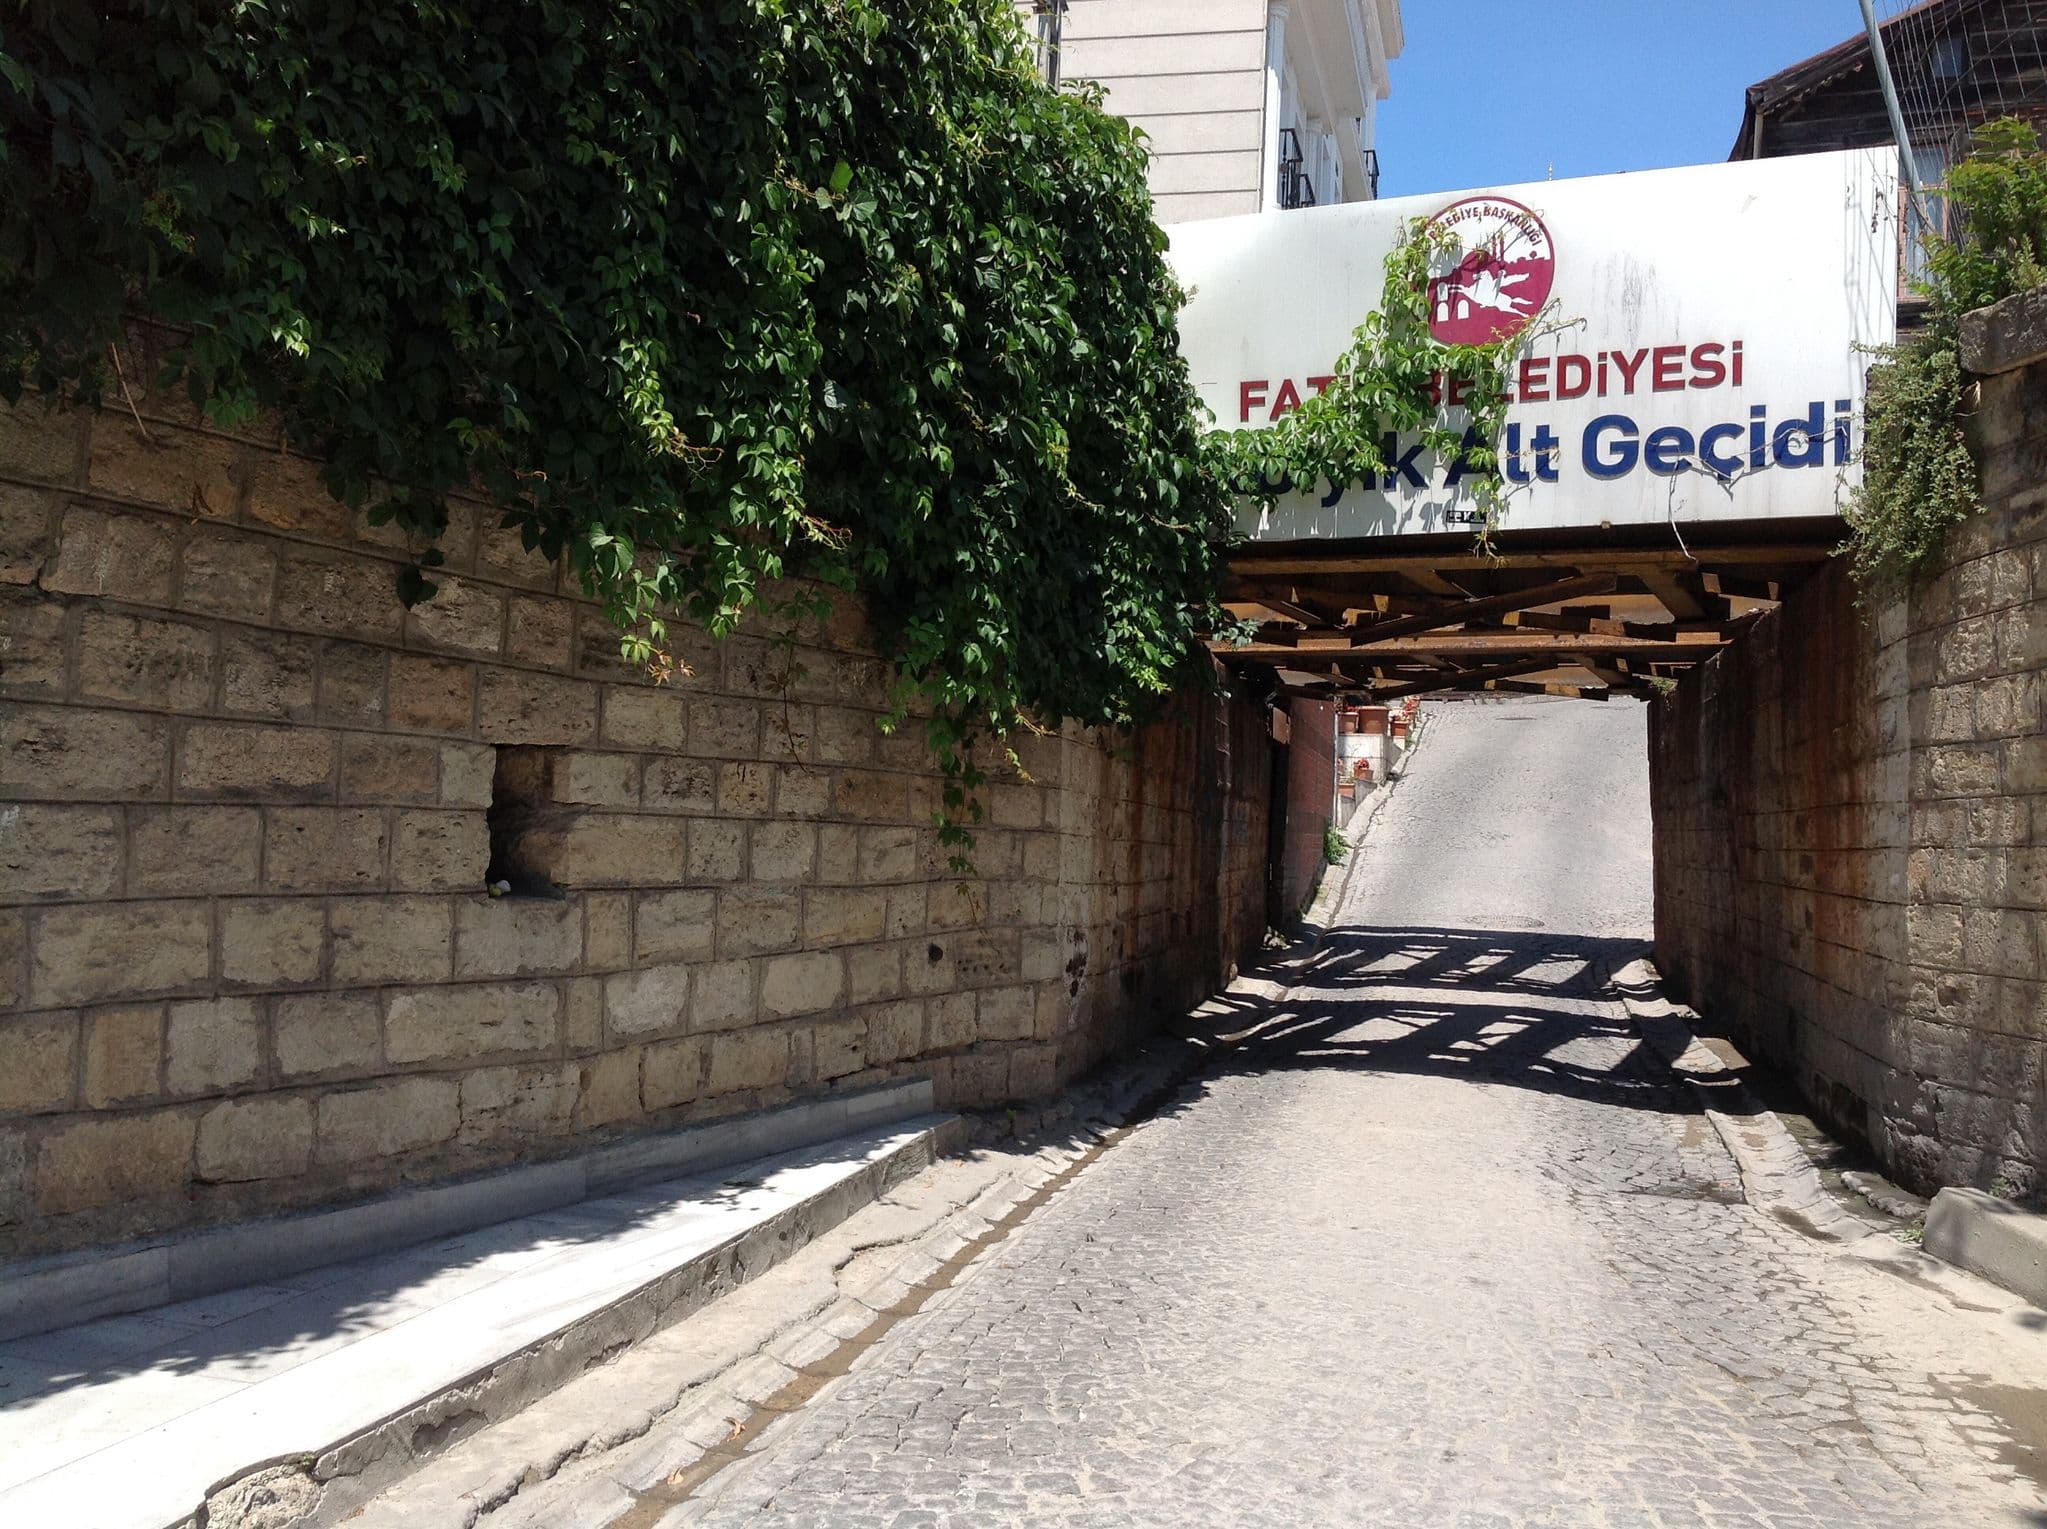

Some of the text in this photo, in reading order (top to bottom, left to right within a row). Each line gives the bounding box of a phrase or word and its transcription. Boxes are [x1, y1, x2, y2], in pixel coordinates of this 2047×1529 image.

[1429, 205, 1479, 240] BEDİYE
[1240, 375, 1351, 423] FAT
[1443, 422, 1560, 488] Alt
[1581, 399, 1851, 484] Geçidi
